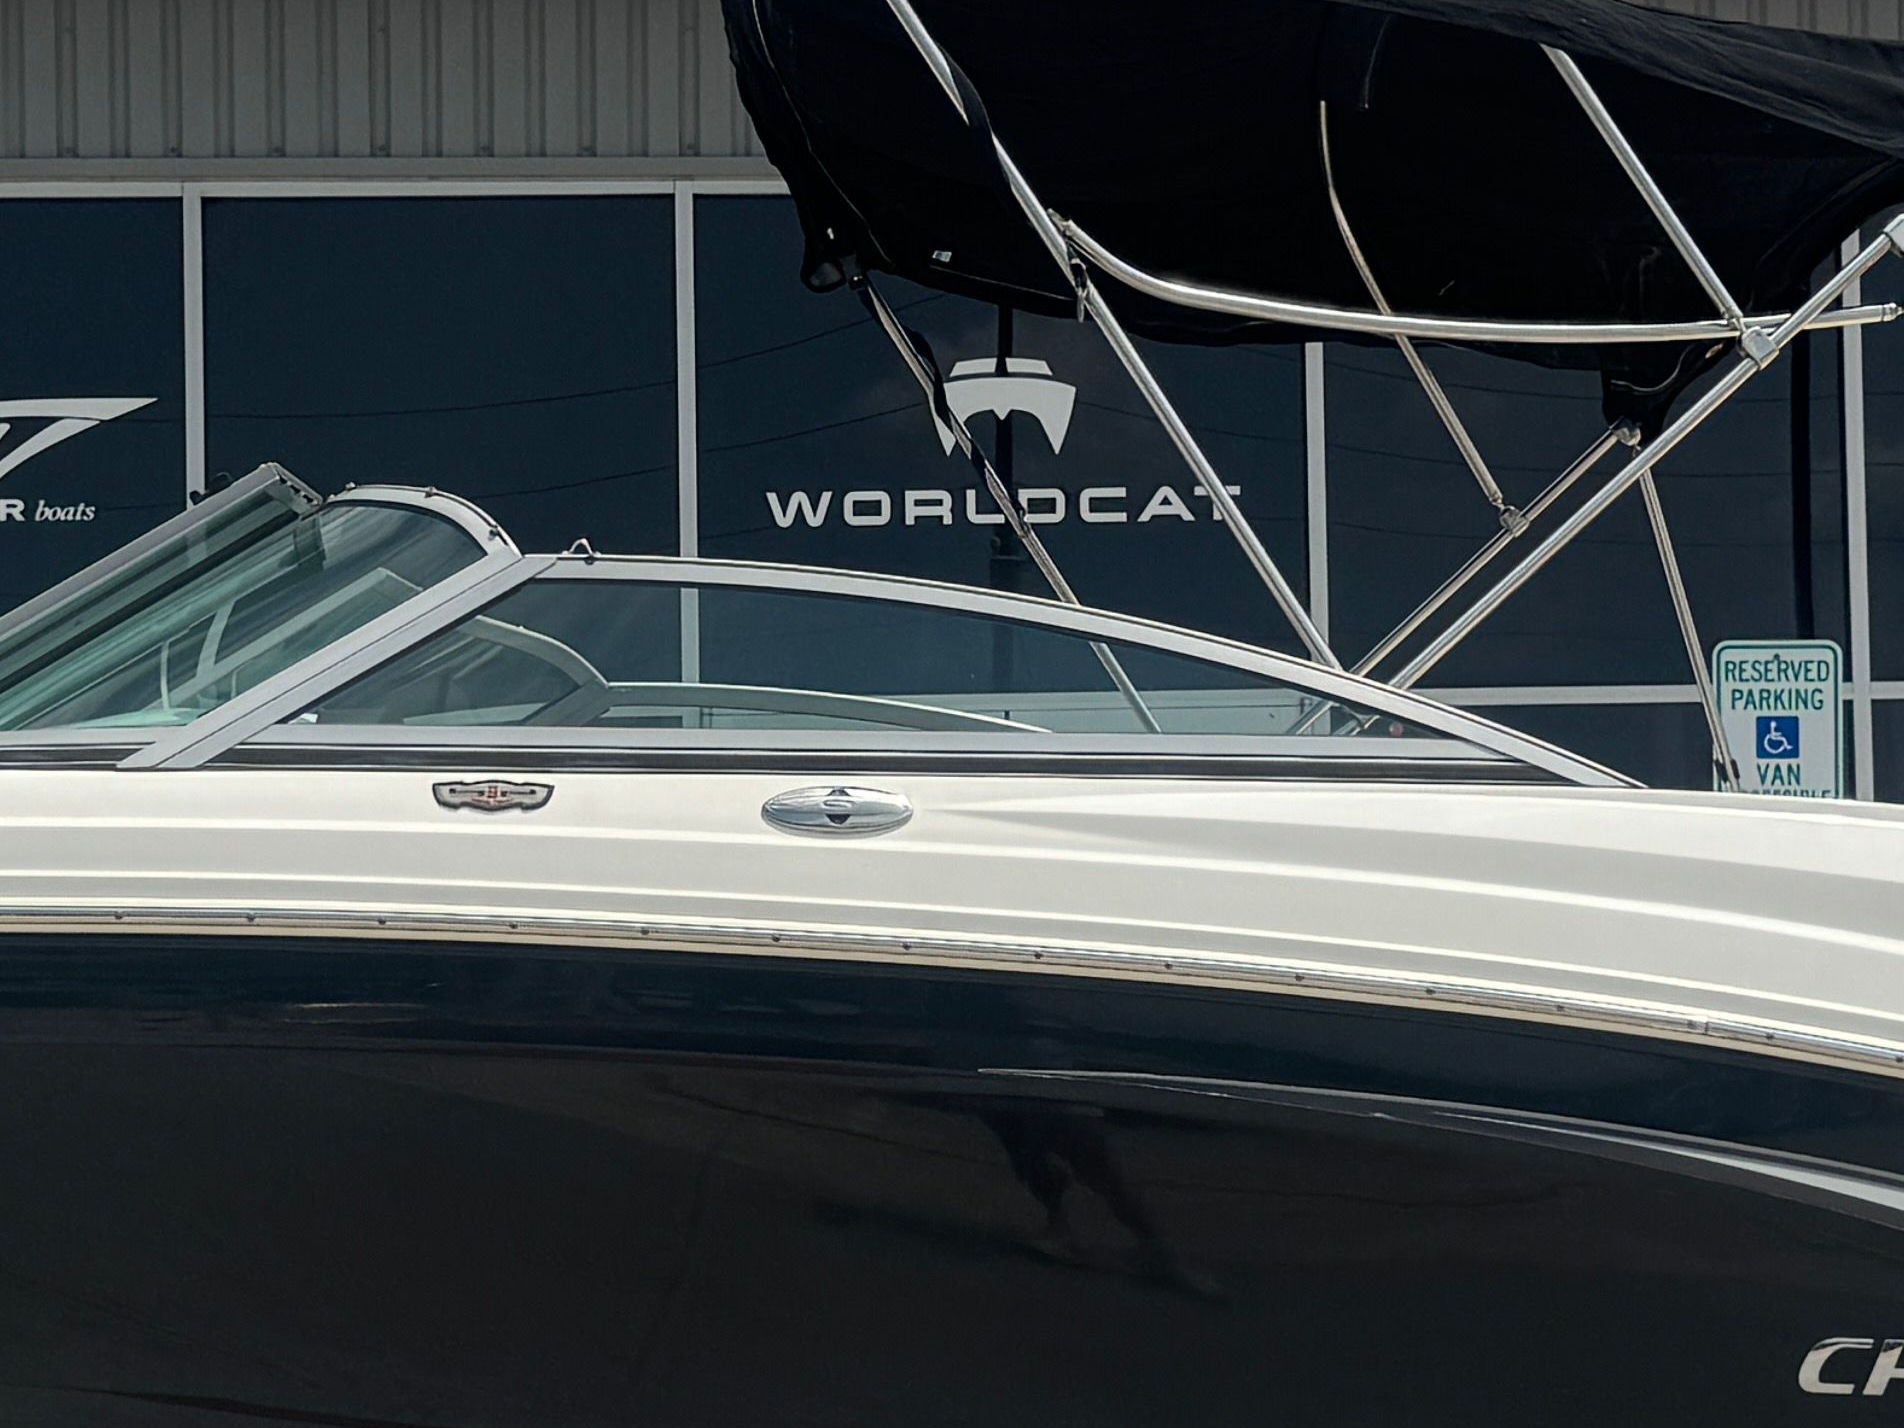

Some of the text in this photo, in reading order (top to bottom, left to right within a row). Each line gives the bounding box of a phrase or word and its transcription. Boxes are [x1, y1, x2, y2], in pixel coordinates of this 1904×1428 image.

[34, 501, 96, 523] boats
[1725, 660, 1830, 683] RESERVED
[1731, 688, 1824, 711] PARKING
[1756, 763, 1801, 787] VAN
